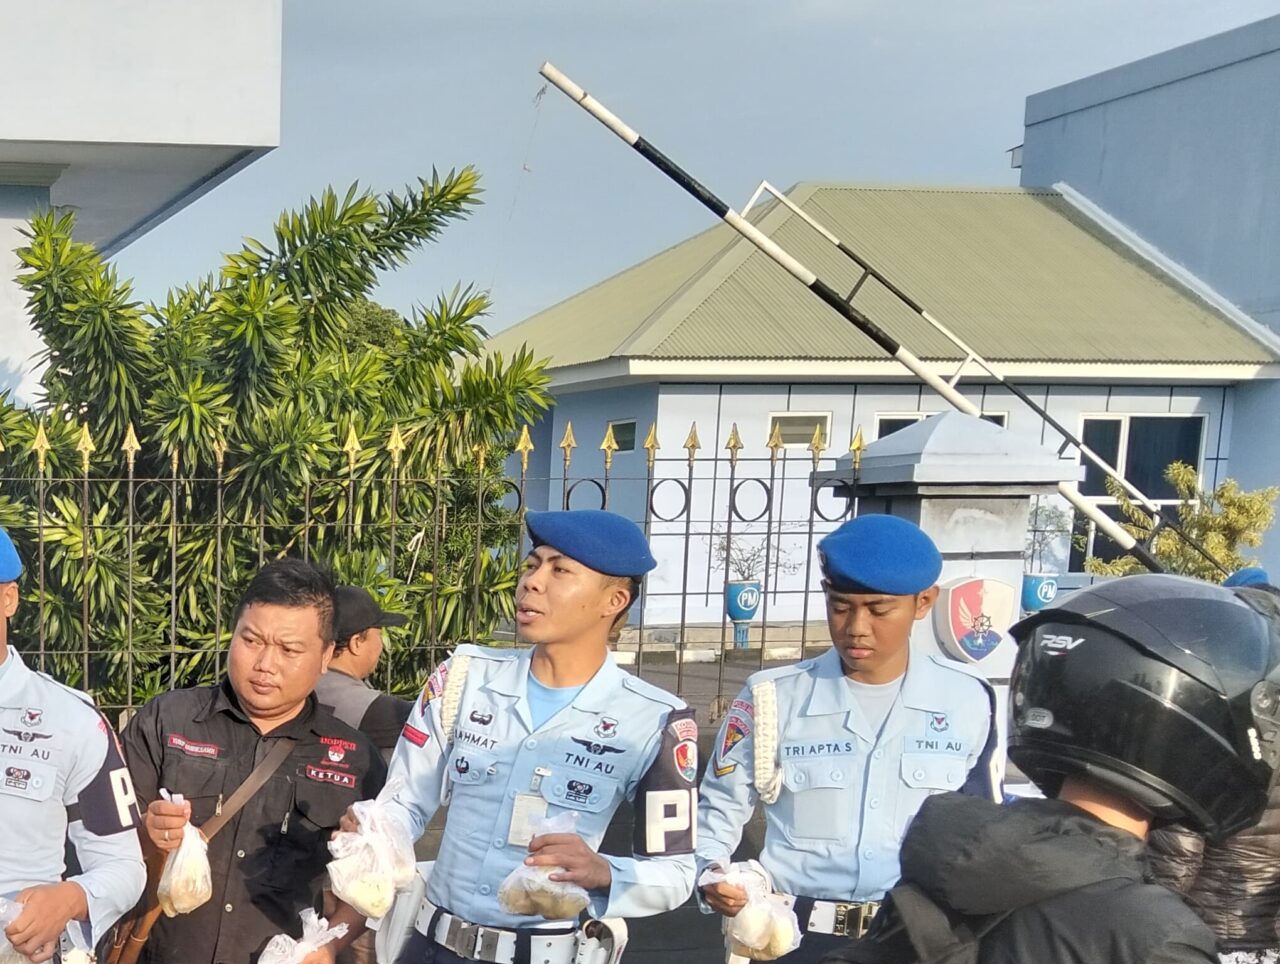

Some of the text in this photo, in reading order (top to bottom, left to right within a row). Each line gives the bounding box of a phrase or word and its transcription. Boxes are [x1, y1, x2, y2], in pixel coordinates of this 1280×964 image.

[1040, 634, 1086, 650] RSV
[0, 744, 50, 761] TNI AU
[785, 742, 852, 756] TRI APTA S
[916, 740, 962, 751] TNI AU
[565, 752, 614, 775] TNI AU
[311, 769, 349, 784] KETUA
